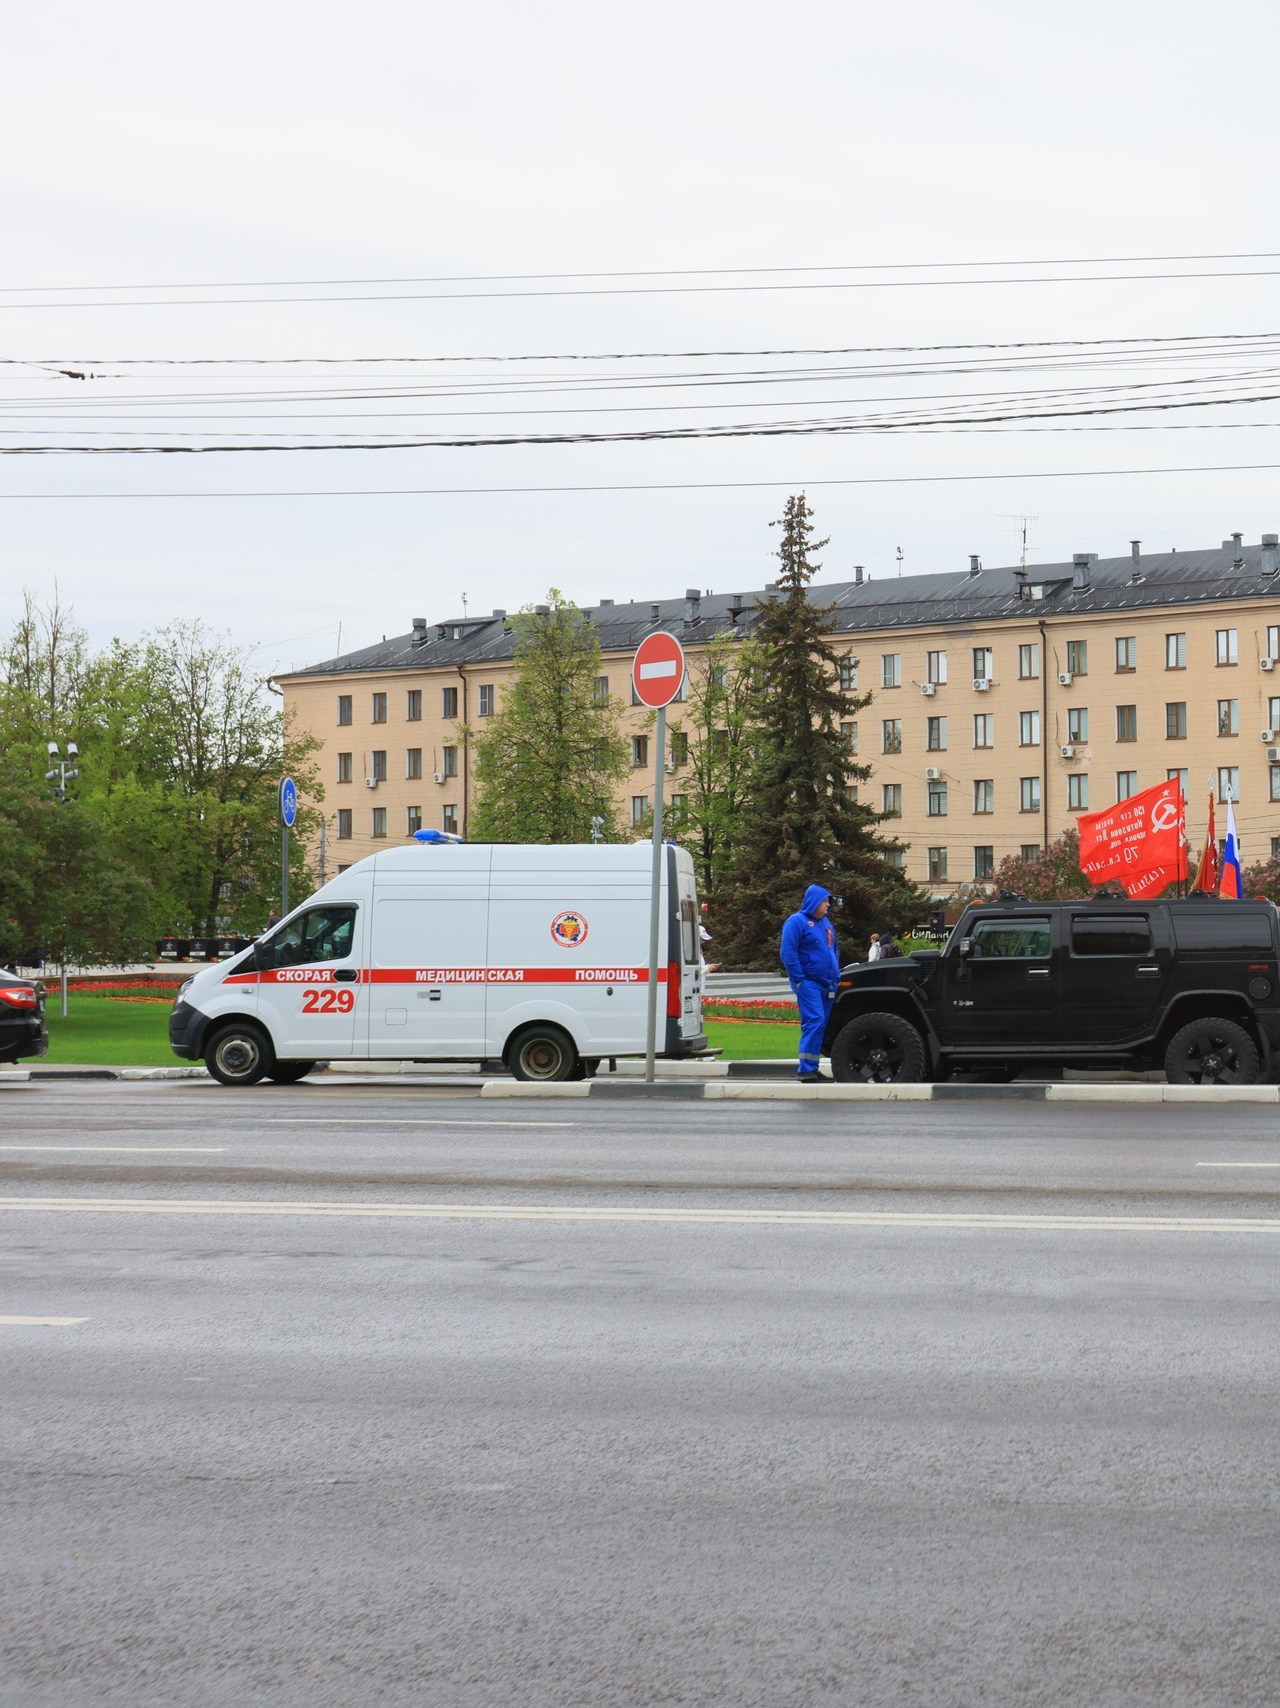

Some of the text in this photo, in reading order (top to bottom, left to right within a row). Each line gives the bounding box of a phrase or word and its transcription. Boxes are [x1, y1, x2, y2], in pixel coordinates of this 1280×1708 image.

[276, 970, 638, 982] СКОРАЯ МЕДИЦИНСКАЯ ПОМОЩЬ
[302, 990, 355, 1014] 229
